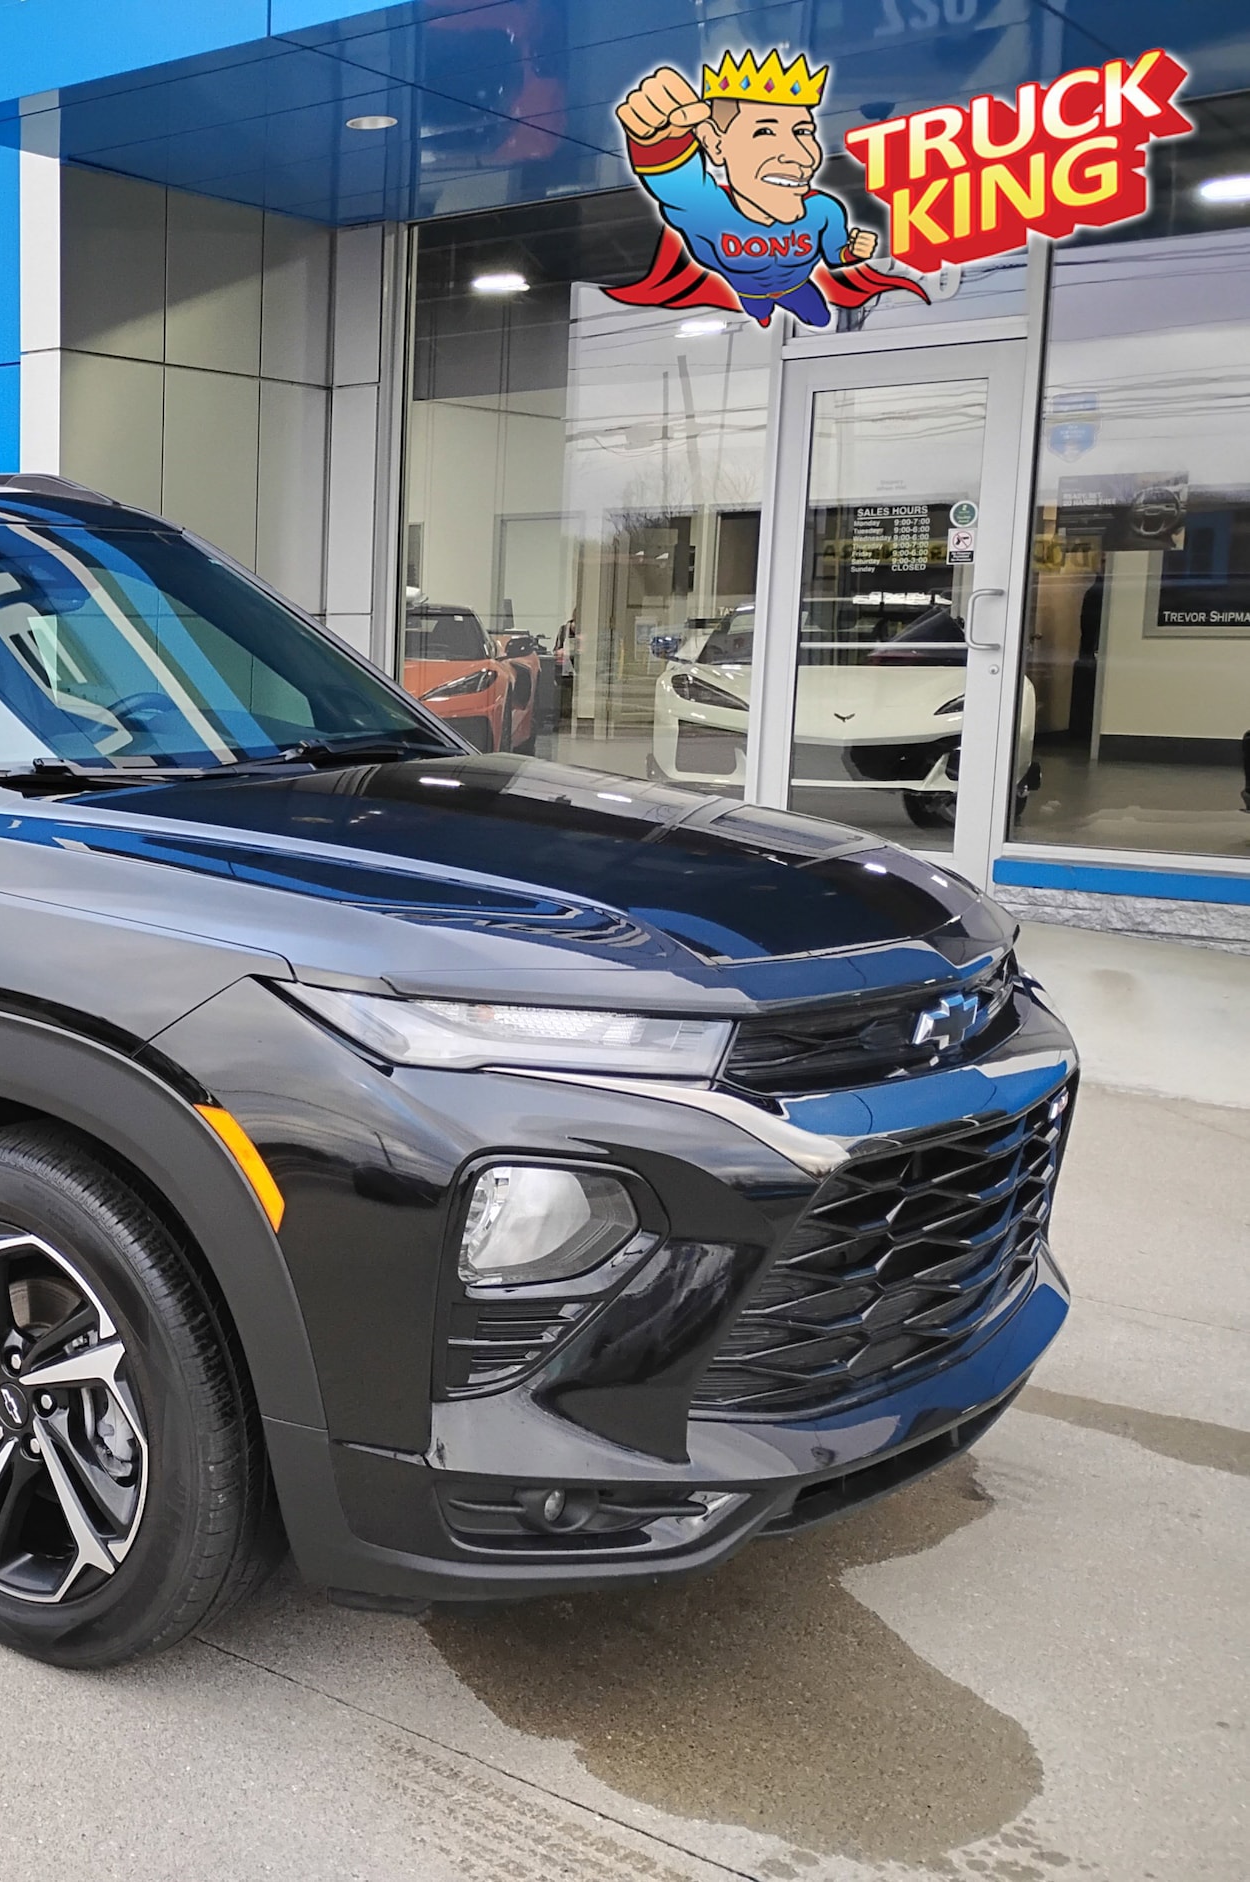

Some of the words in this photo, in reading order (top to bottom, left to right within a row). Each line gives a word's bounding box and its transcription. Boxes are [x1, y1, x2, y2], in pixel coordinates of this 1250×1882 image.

[857, 507, 890, 517] SALES
[892, 505, 928, 515] HOURS
[853, 519, 880, 527] Monday
[853, 527, 884, 535] Tuesday
[852, 542, 883, 550] Thursday
[851, 550, 872, 558] Friday
[851, 557, 880, 565] Saturday
[850, 565, 875, 573] Sunday
[891, 563, 927, 572] CLOSED
